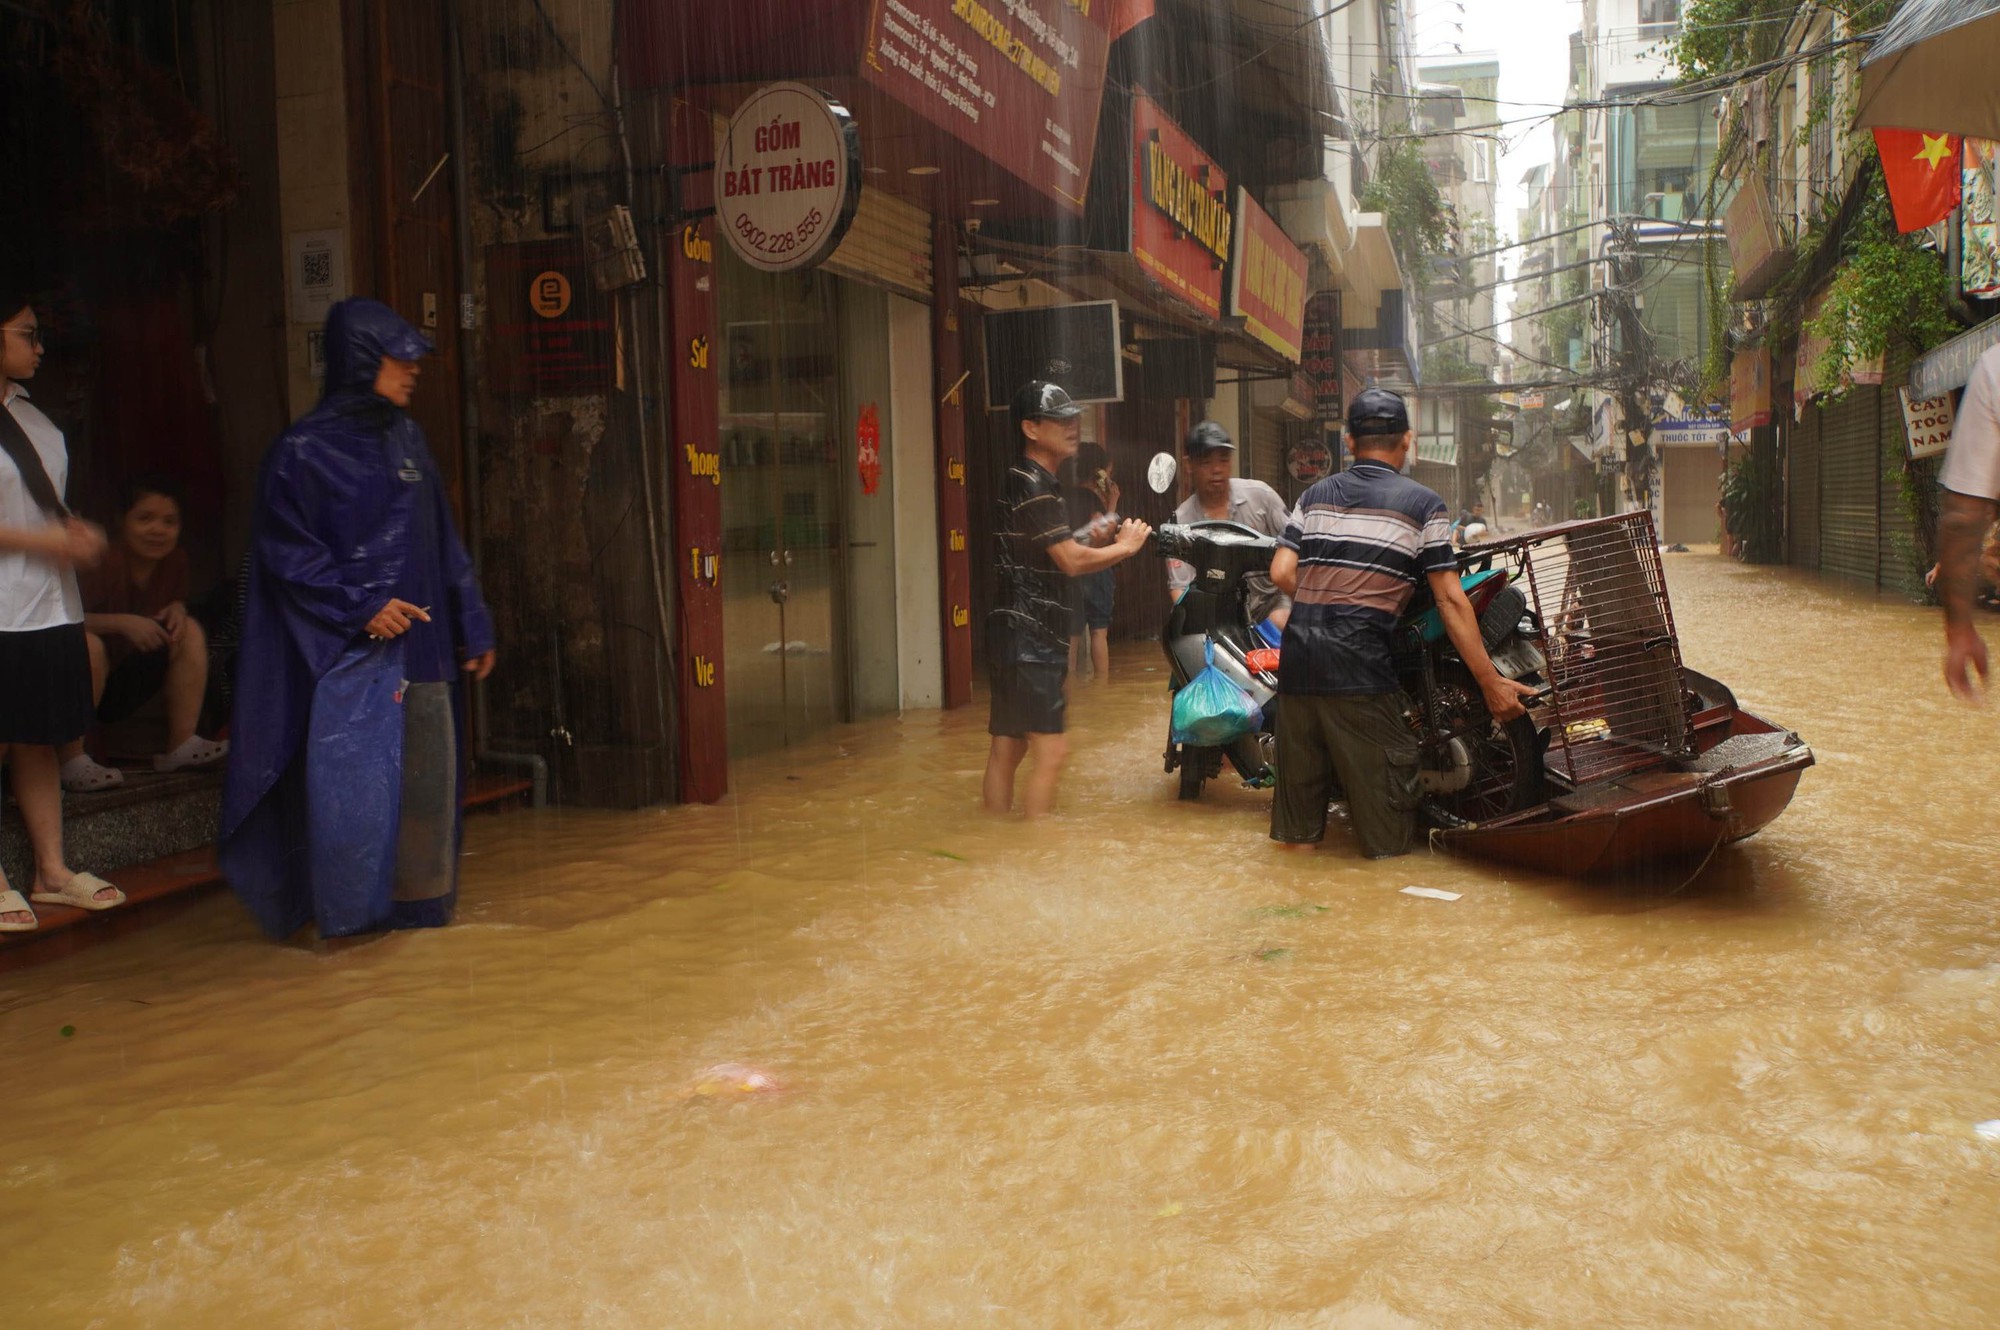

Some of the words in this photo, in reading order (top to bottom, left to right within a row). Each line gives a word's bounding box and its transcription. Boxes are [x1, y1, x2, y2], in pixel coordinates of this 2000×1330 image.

[755, 114, 800, 152] GỐM
[724, 163, 762, 198] BÁT
[768, 158, 835, 193] TRÀNG
[684, 223, 712, 263] Gốm
[735, 206, 822, 254] 0902.228.555
[691, 335, 708, 369] Sứ
